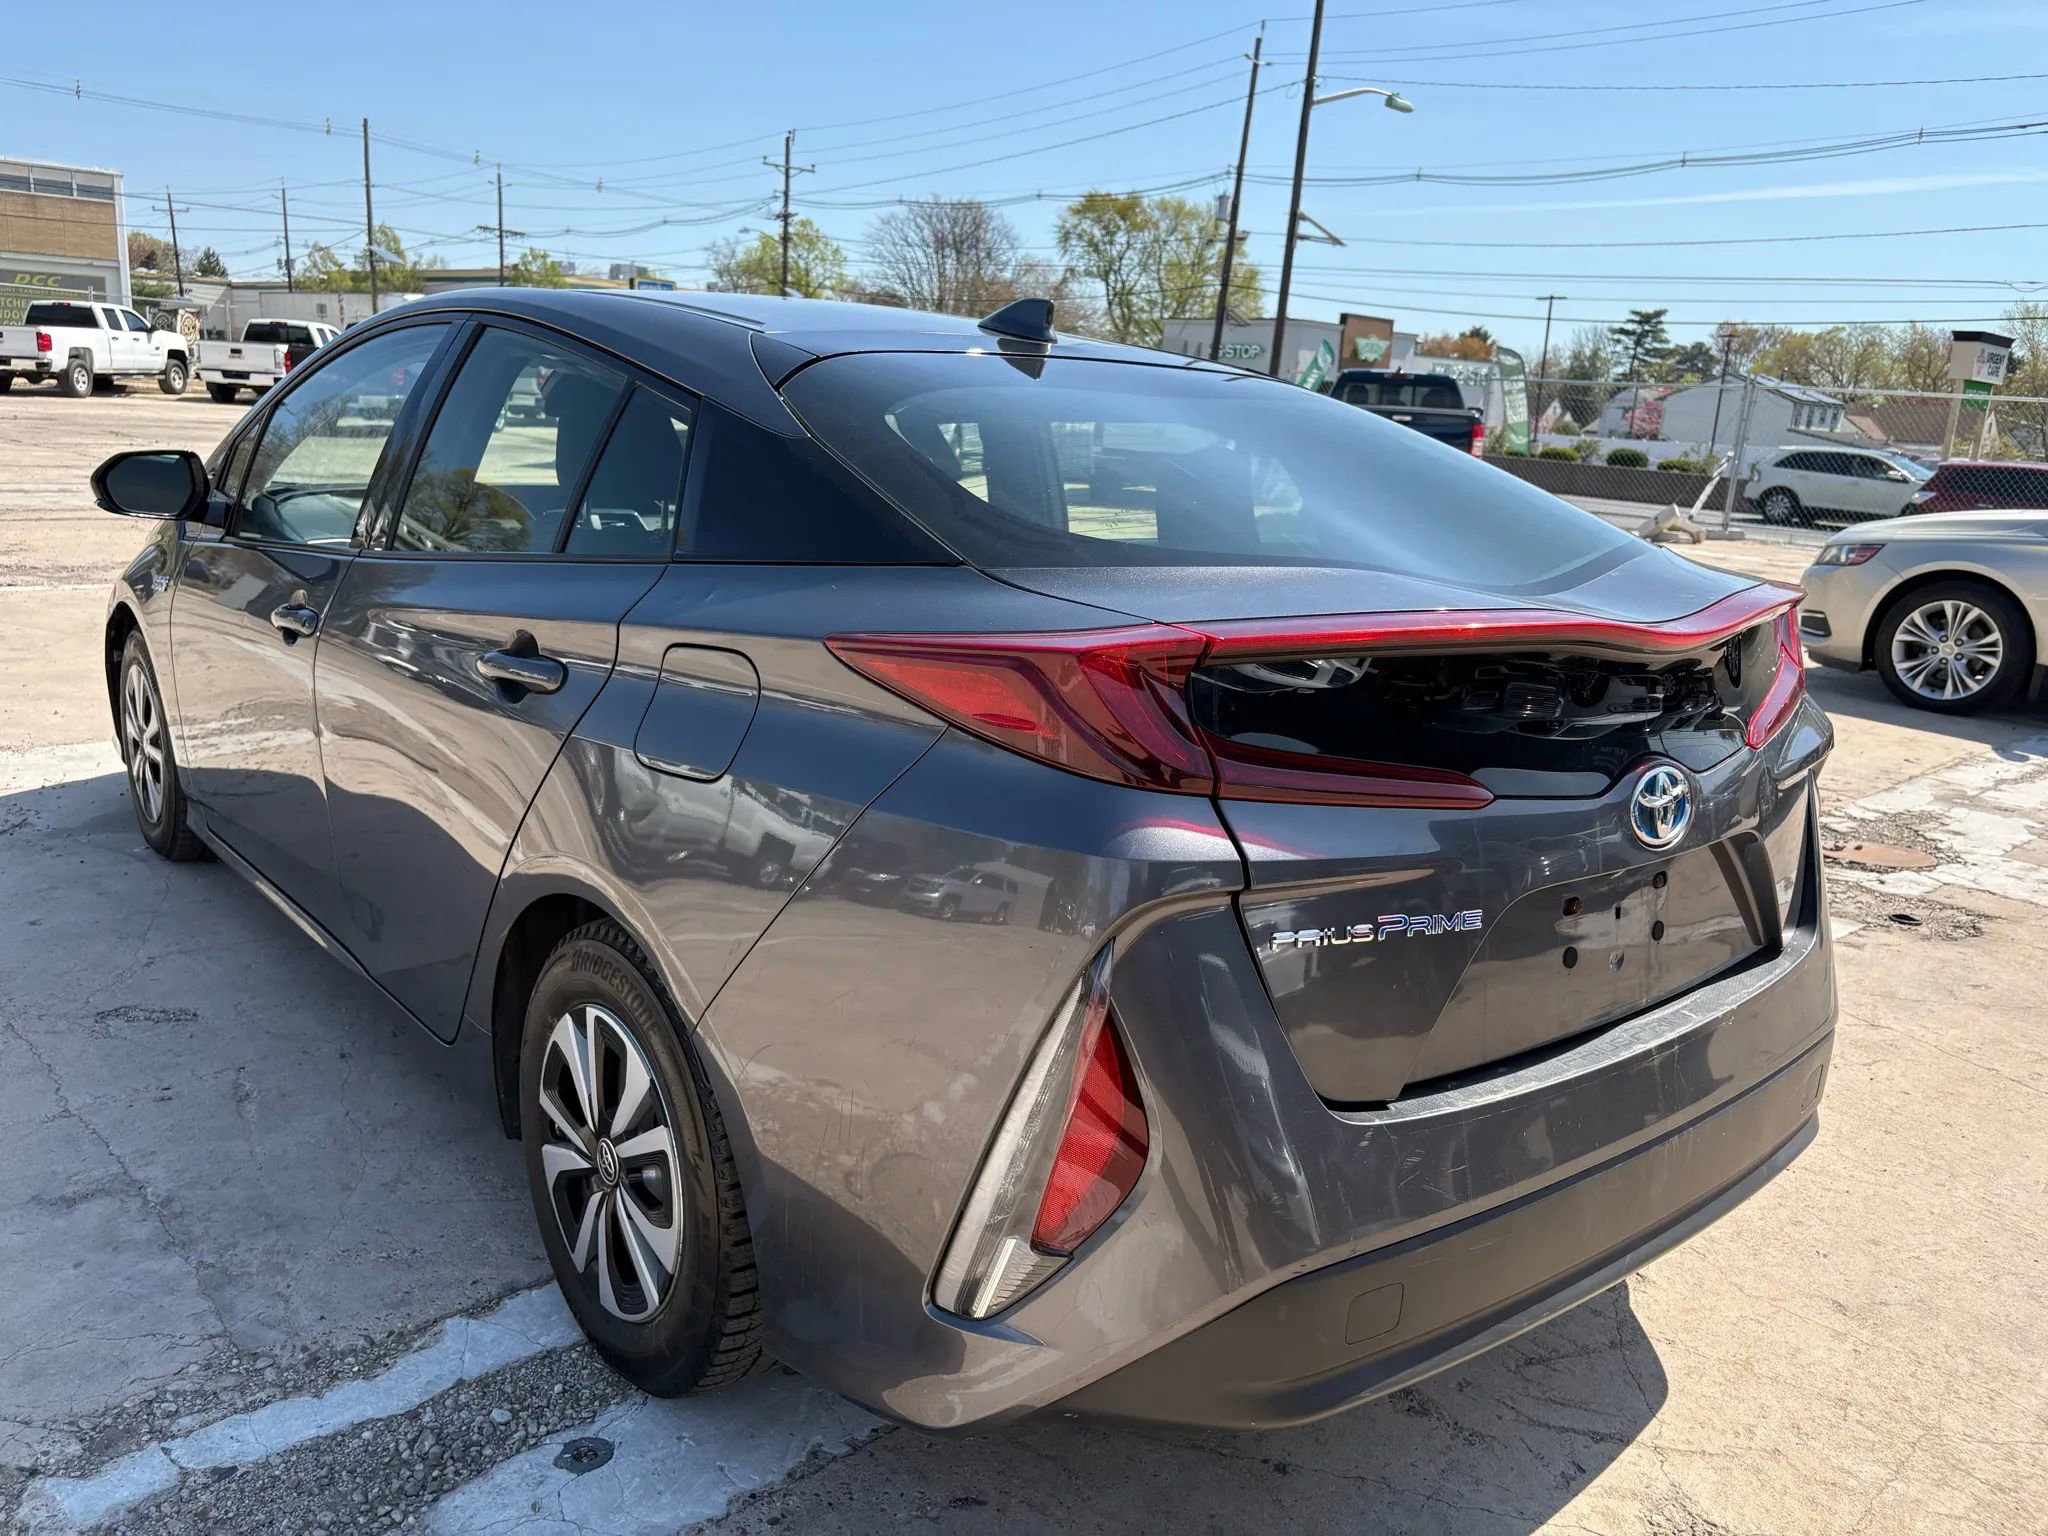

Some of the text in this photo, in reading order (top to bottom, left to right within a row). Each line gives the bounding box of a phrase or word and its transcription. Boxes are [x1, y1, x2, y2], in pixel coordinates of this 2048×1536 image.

[15, 273, 62, 287] DCC
[1269, 909, 1482, 951] PRIUS PRIME
[570, 948, 662, 1037] BRIDGESTONE
